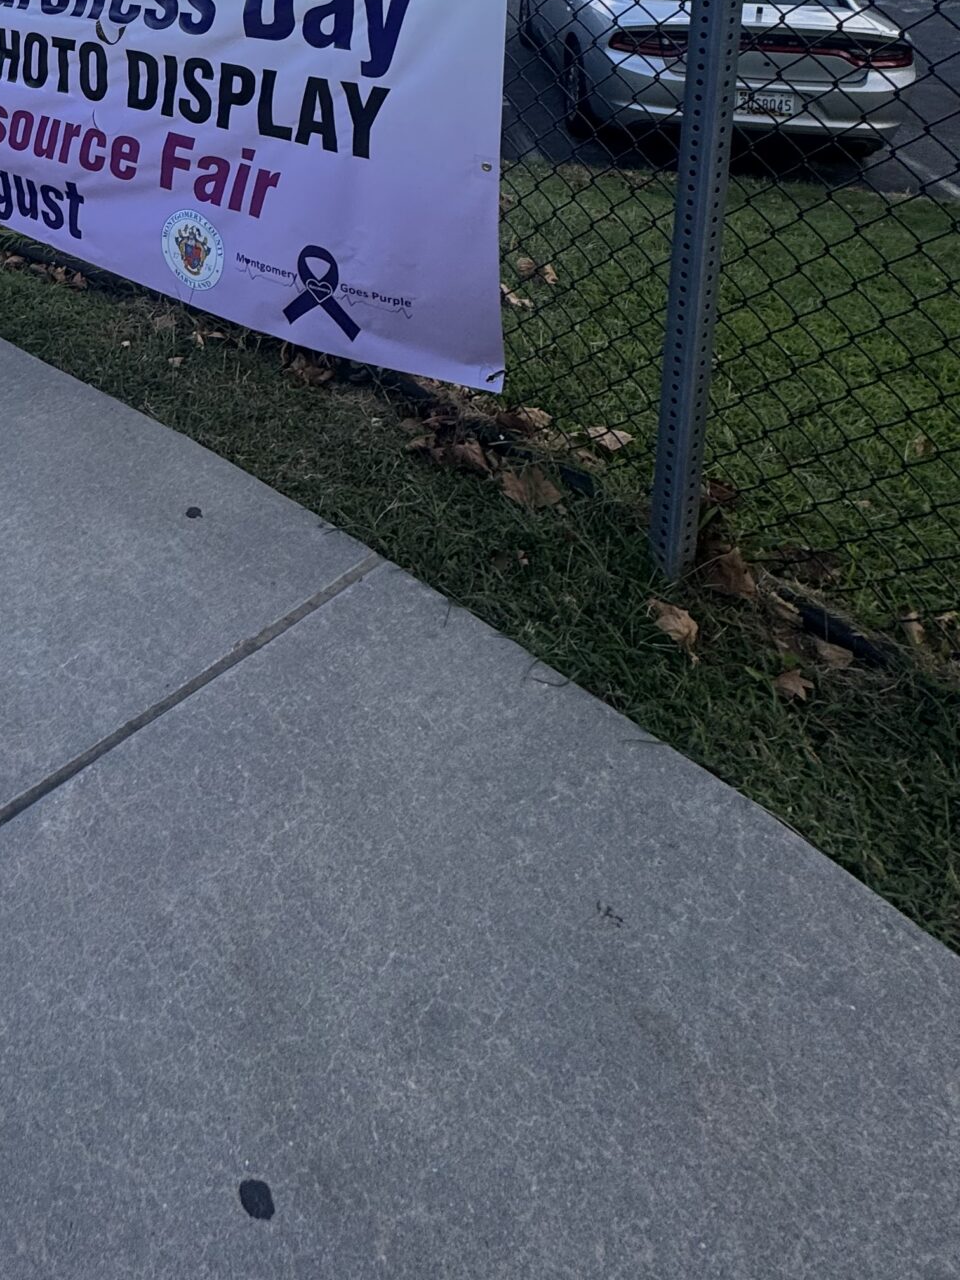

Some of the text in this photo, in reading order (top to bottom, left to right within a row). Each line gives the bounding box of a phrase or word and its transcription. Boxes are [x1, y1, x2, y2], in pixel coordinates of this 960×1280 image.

[125, 49, 391, 159] DISPLAY
[159, 132, 281, 219] Fair
[163, 211, 203, 238] MONTGOMERY
[175, 269, 212, 288] MARYLAND
[340, 283, 369, 298] Goes
[372, 291, 412, 308] Purple
